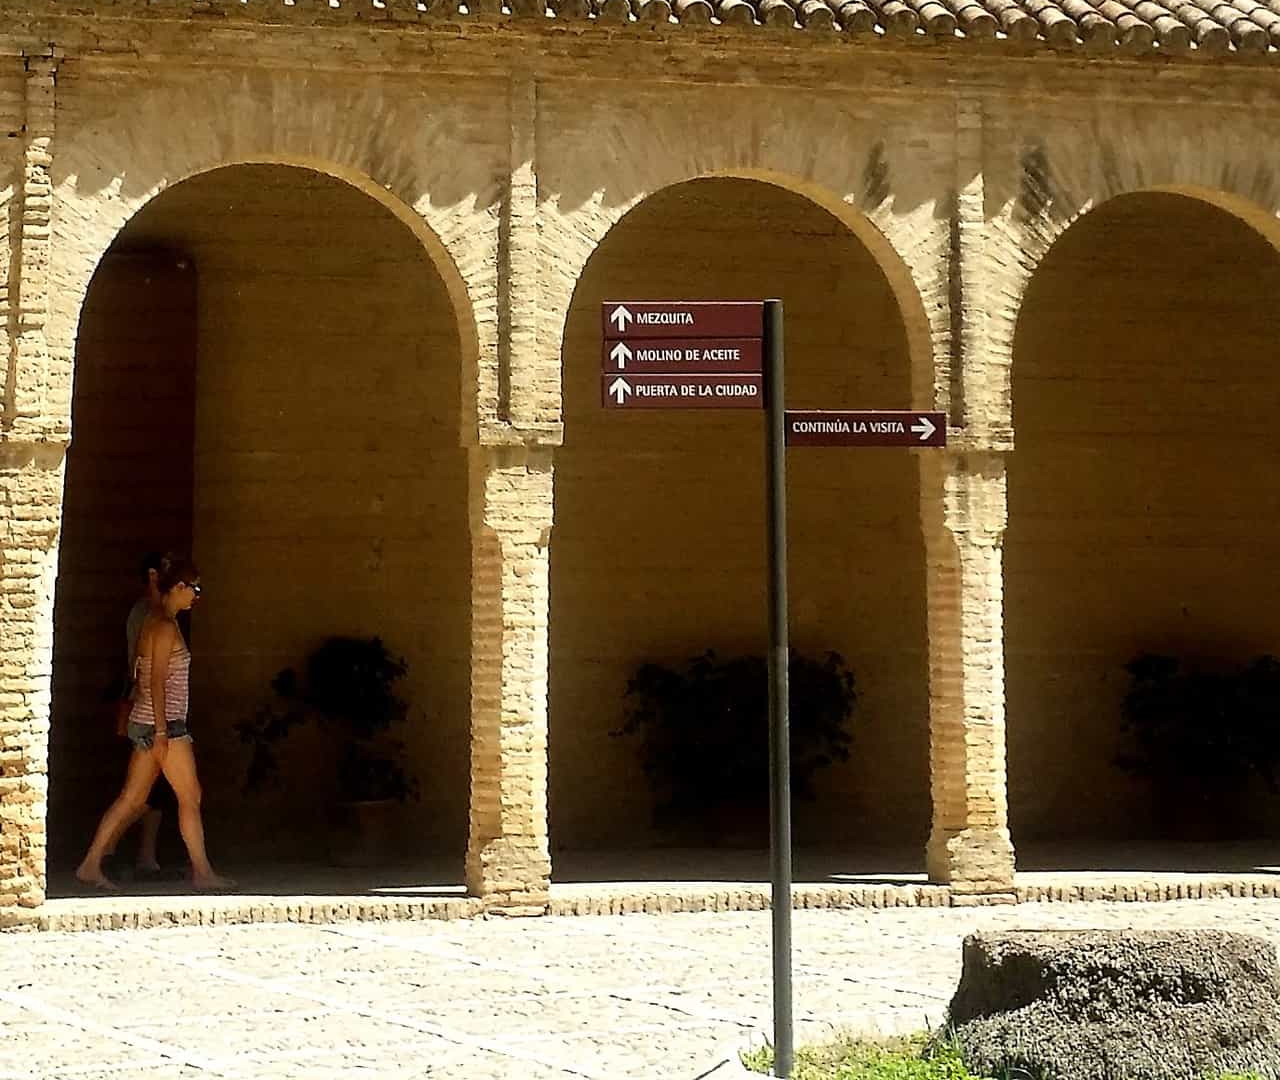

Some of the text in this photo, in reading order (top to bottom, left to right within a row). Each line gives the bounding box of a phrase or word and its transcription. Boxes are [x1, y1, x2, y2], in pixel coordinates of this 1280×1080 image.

[636, 312, 694, 324] MEZQUITA
[636, 349, 740, 361] MOLINO DE ACEITE
[635, 384, 758, 396] PUERTA DE LA CIUDAD
[792, 418, 905, 433] CONTINÚA LA VISITA
